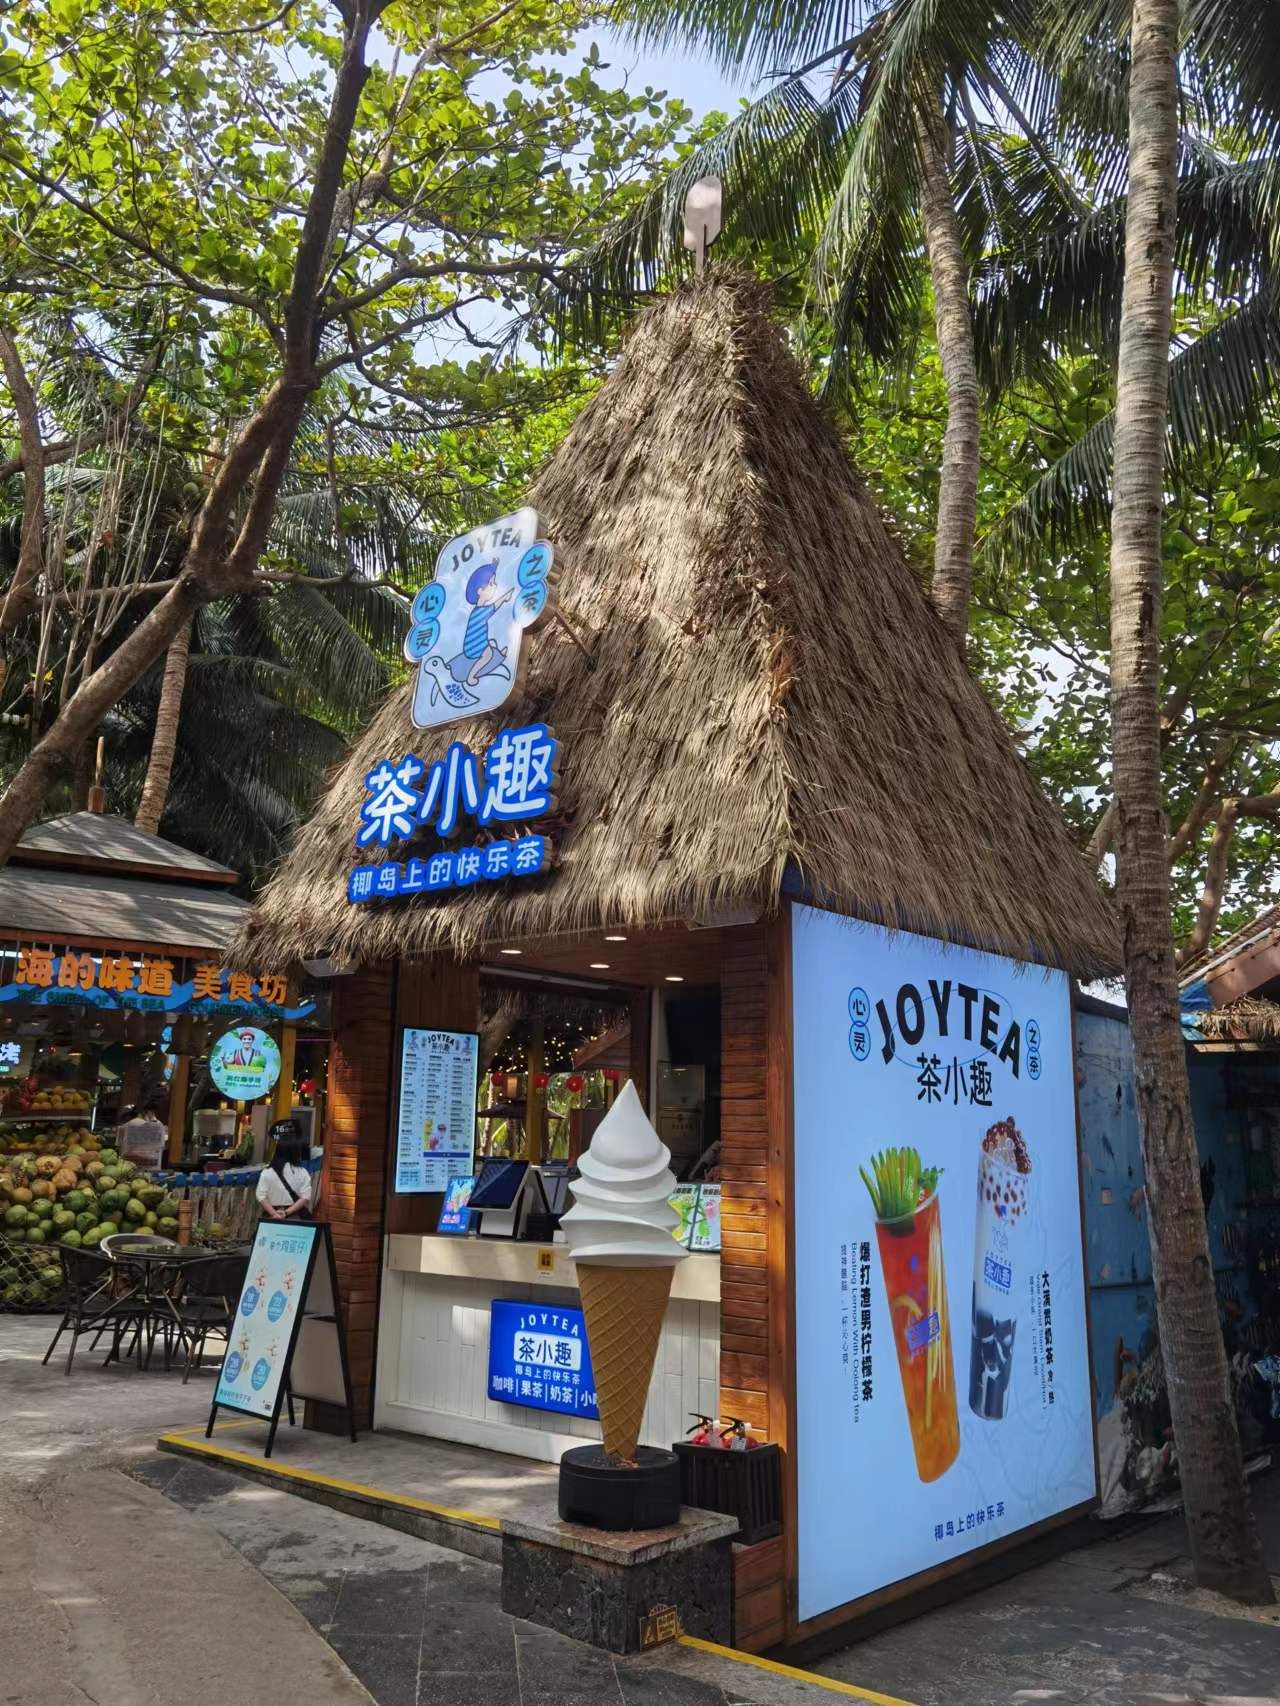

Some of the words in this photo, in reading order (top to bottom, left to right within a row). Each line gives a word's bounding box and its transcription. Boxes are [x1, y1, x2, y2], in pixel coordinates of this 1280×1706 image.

[452, 528, 521, 572] JOYTEA
[413, 594, 439, 650] 心灵
[360, 730, 552, 842] 茶小趣
[351, 840, 542, 897] 椰岛上的快乐茶
[15, 948, 175, 997] 海的味道
[192, 964, 287, 1005] 美食坊
[428, 1034, 455, 1045] JOYTEA
[852, 998, 866, 1053] 心灵
[875, 979, 1021, 1080] JOYTEA
[1028, 1026, 1039, 1073] 之茶
[916, 1051, 993, 1107] 茶小趣
[520, 1313, 579, 1337] JOYTEA
[515, 1364, 581, 1385] 椰岛上的快乐茶
[519, 1337, 572, 1367] 茶小趣
[934, 1501, 1005, 1542] 椰岛上的快乐茶
